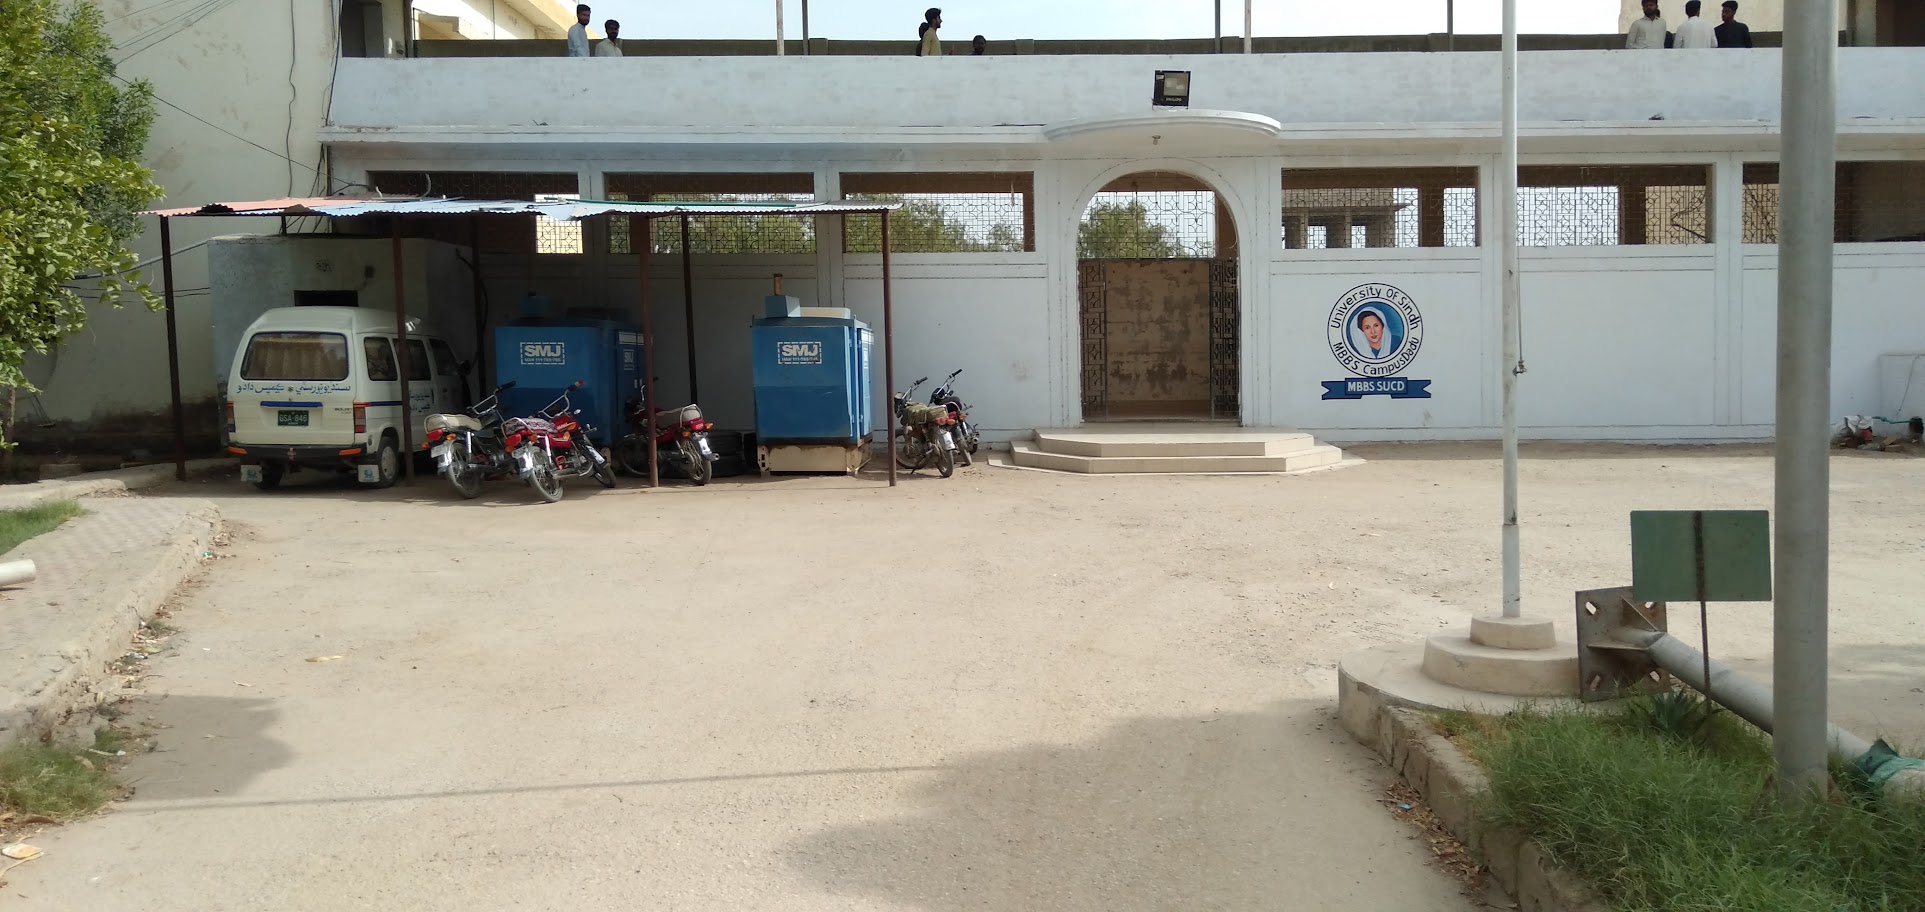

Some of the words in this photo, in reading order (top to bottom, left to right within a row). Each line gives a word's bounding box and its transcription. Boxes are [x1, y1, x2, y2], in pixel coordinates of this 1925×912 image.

[1330, 286, 1382, 329] University
[1397, 297, 1421, 330] Sindh
[524, 345, 561, 357] SMJ
[782, 345, 818, 356] SMJ
[1333, 341, 1359, 370] MBBS
[236, 382, 254, 394] دادو
[1348, 381, 1374, 392] MBBS
[1377, 380, 1405, 391] SUCD
